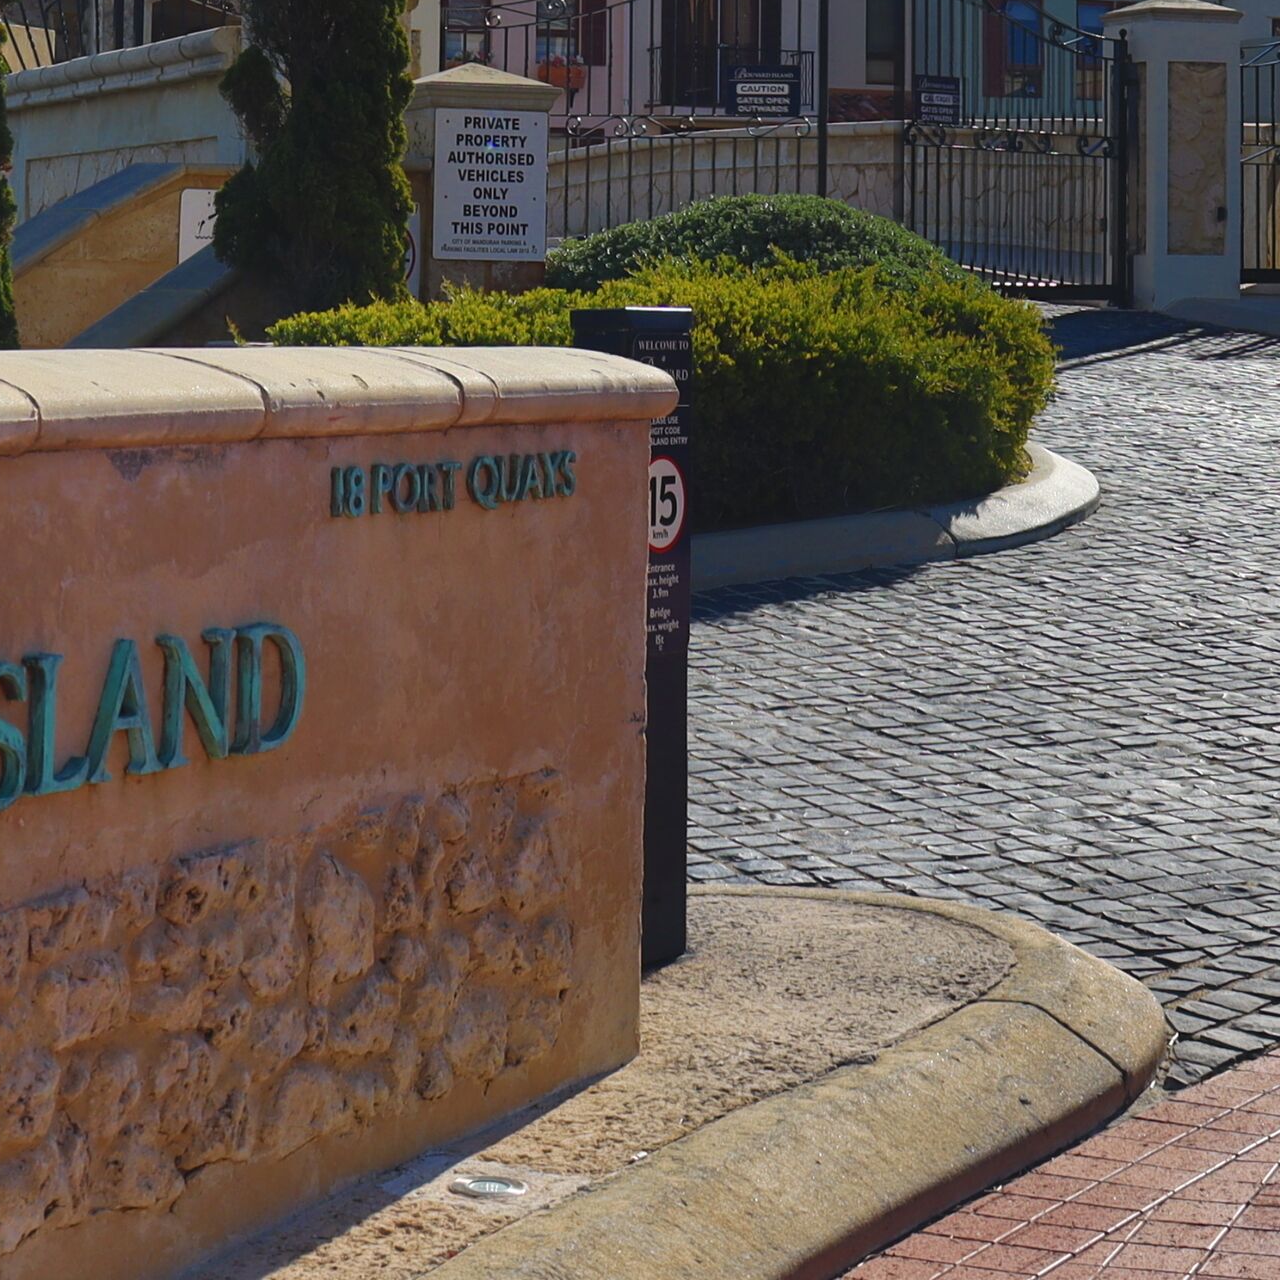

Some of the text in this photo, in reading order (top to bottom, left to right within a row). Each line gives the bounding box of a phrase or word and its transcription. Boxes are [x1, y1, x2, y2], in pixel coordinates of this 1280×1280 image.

[464, 116, 520, 130] PRIVATE
[456, 134, 527, 148] PROPERTY
[447, 151, 535, 166] AUTHORISED
[458, 169, 524, 183] VEHICLES
[473, 187, 509, 200] ONLY
[463, 204, 518, 218] BEYOND
[452, 222, 528, 236] THIS POINT
[638, 340, 689, 350] WELCOME TO
[667, 416, 678, 424] USE
[664, 426, 680, 435] CODE
[670, 436, 688, 445] ENTRY
[330, 450, 577, 518] 18 PORT QUAYS
[649, 475, 677, 526] 15
[652, 528, 668, 539] km/h
[659, 574, 679, 587] height
[649, 607, 671, 619] Bridge
[658, 619, 679, 632] weight
